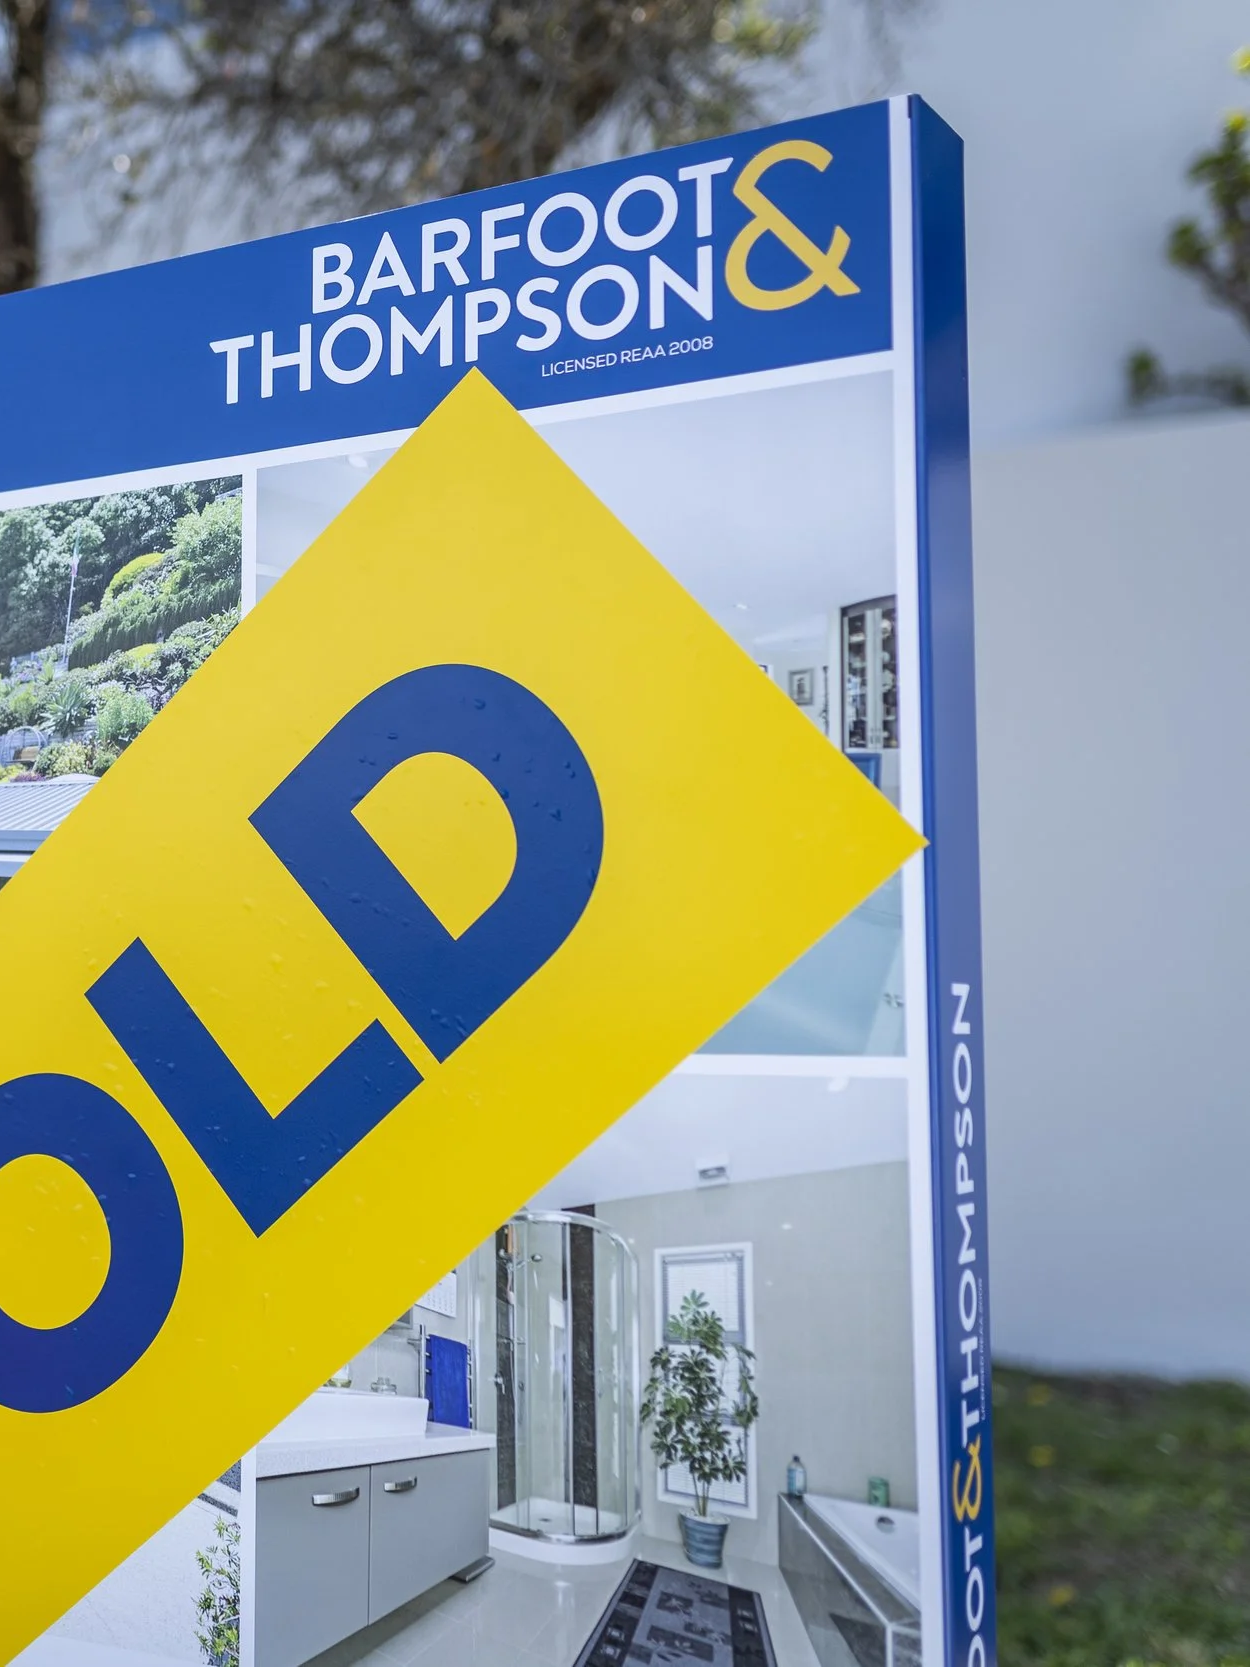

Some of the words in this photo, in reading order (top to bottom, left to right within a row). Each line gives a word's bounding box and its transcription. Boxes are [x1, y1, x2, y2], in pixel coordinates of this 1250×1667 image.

[311, 156, 734, 315] BARFOOT
[724, 140, 861, 312] &
[209, 243, 714, 406] THOMPSON
[541, 352, 618, 378] LICENSED
[620, 344, 666, 364] REAA
[668, 335, 714, 356] 2008
[951, 982, 981, 1448] THOMPSON
